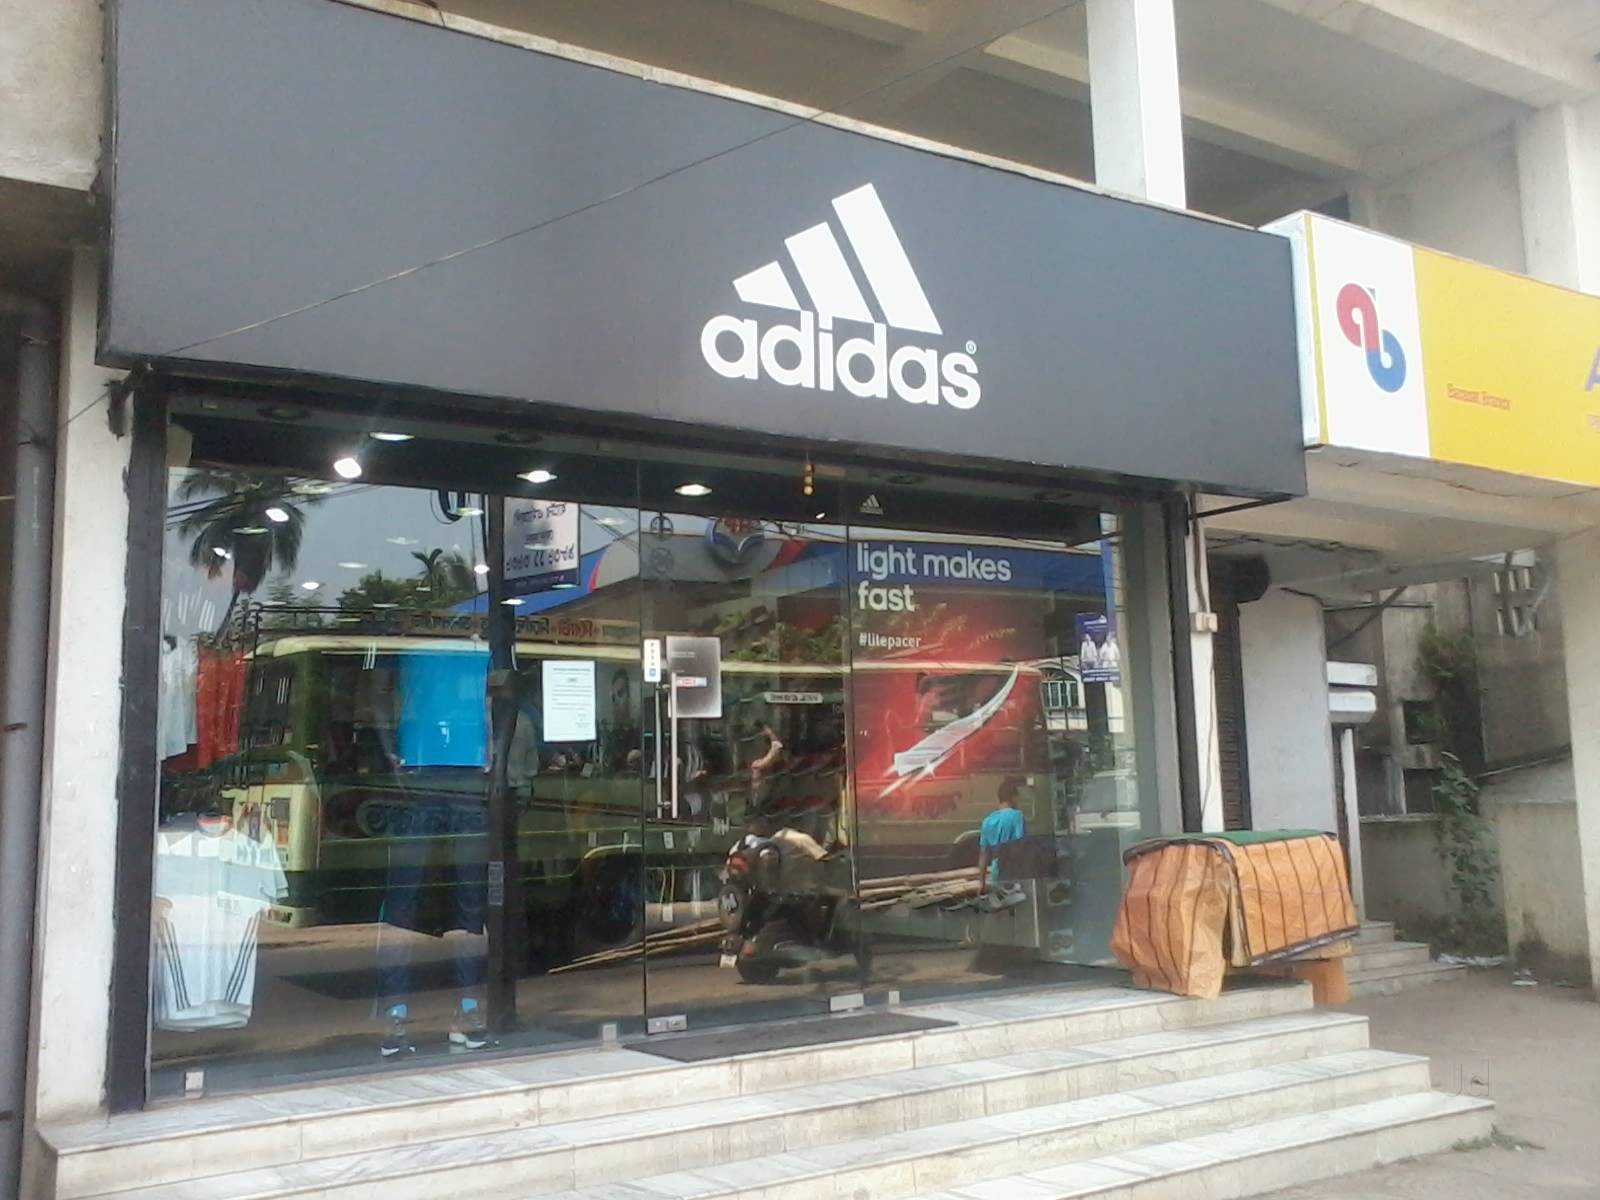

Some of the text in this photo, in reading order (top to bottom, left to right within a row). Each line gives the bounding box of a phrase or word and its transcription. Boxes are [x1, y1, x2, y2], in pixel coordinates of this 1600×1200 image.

[700, 310, 981, 410] adidas
[857, 542, 1012, 582] light makes
[858, 580, 916, 612] fast
